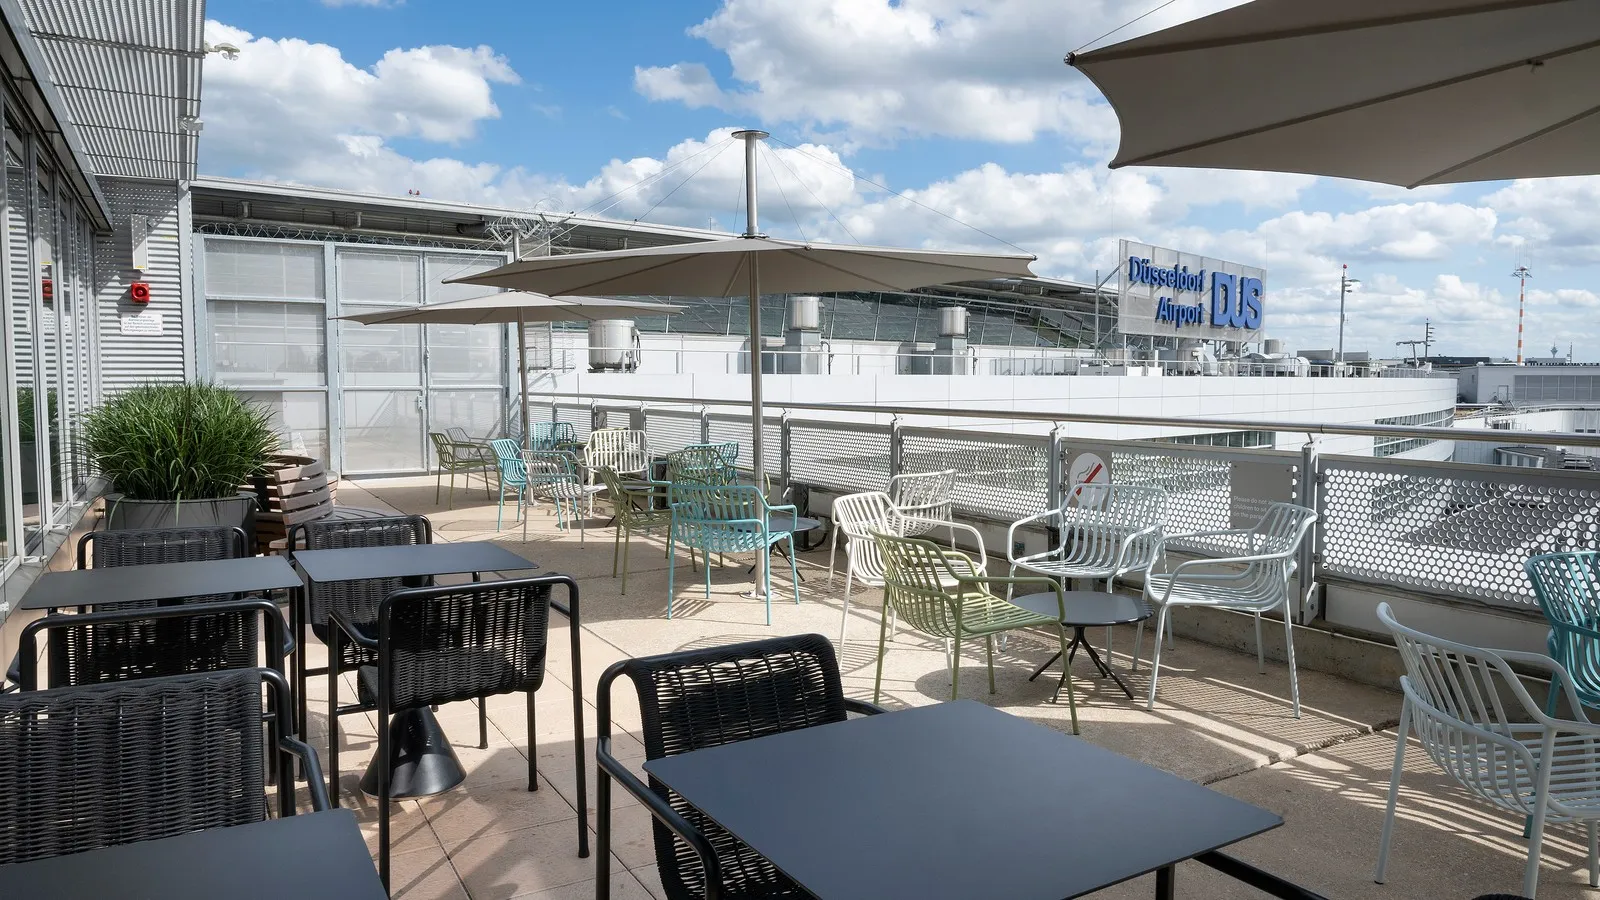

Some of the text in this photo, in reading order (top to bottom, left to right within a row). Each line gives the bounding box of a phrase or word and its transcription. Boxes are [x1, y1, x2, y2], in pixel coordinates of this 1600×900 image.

[1129, 256, 1206, 292] Düsseldorf
[1155, 296, 1206, 328] Airport
[1211, 271, 1263, 329] DUS
